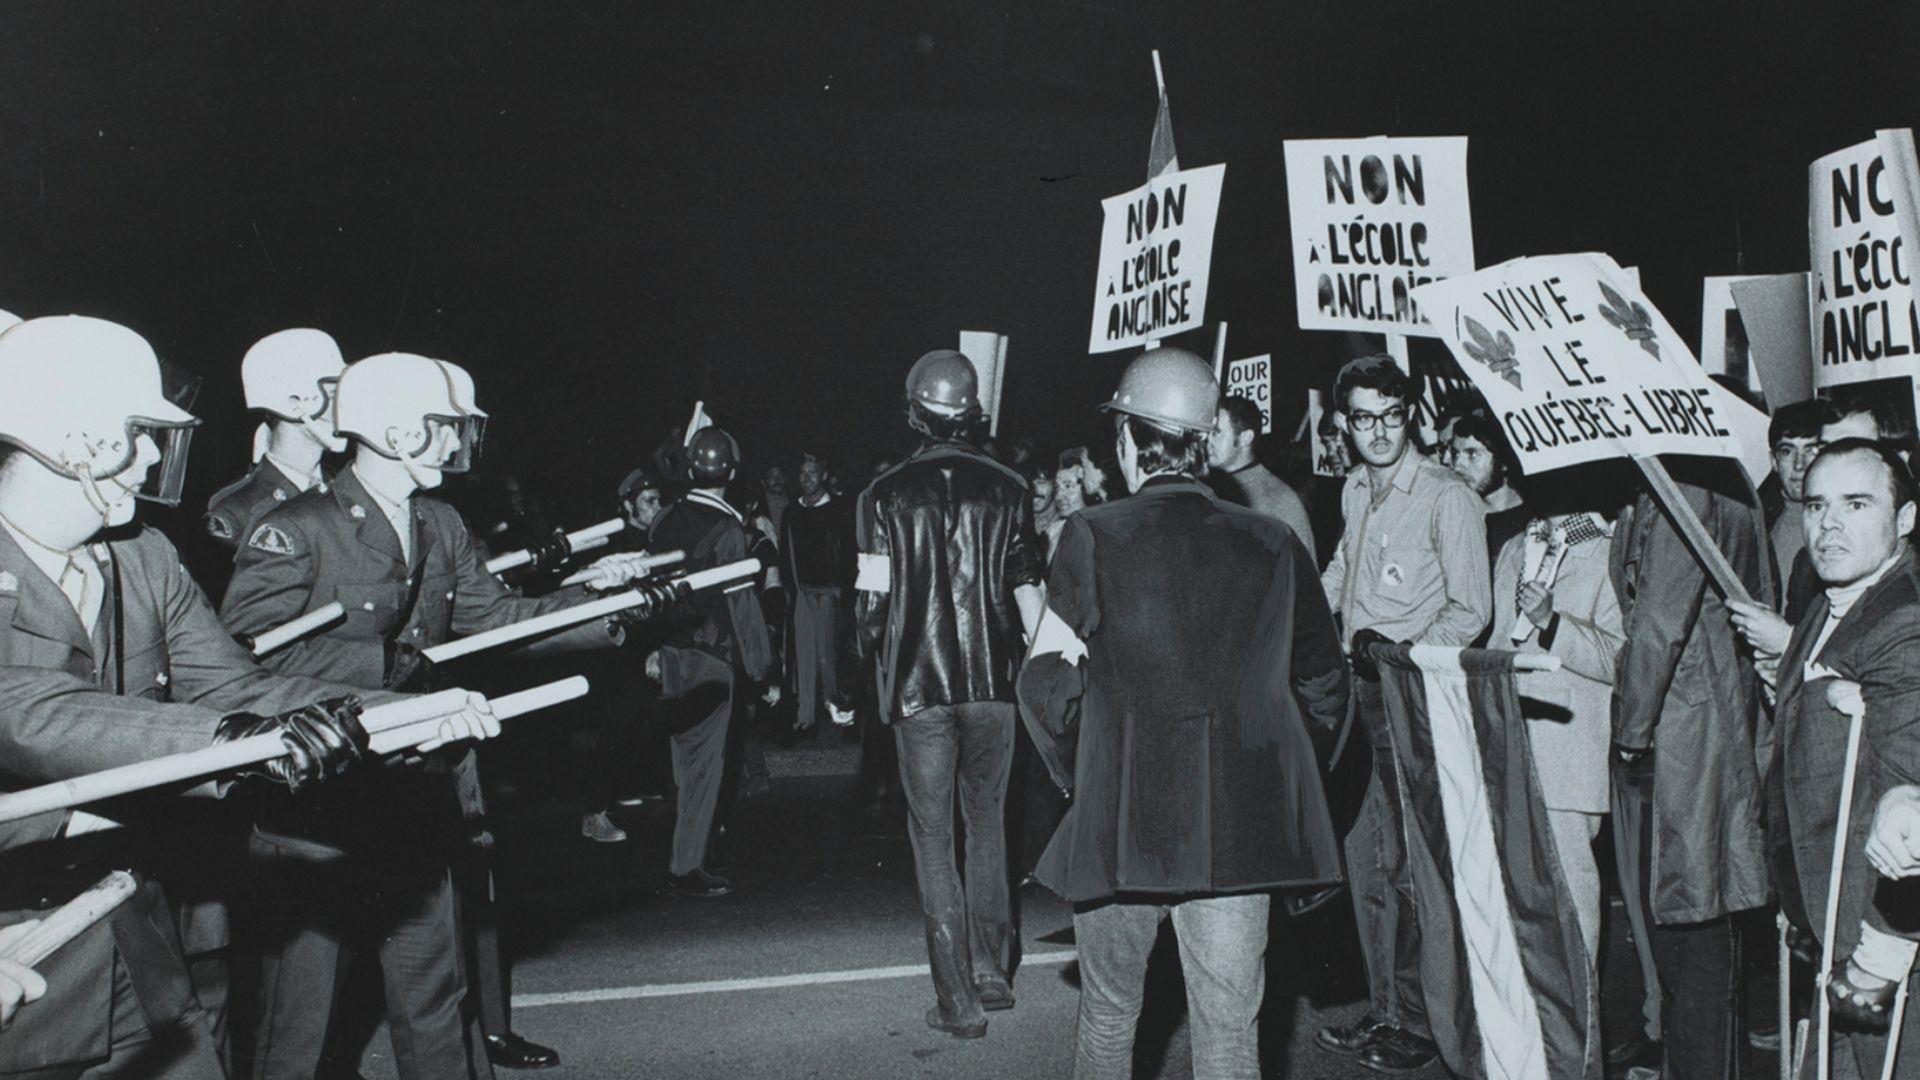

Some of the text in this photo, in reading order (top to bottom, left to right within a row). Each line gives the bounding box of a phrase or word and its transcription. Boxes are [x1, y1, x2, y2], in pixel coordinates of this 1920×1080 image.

[1323, 153, 1425, 206] NON
[1127, 183, 1187, 245] NON
[1483, 277, 1586, 333] VIVE
[1543, 340, 1607, 386] LE
[1503, 385, 1731, 452] QUÉBEC-LIBRE
